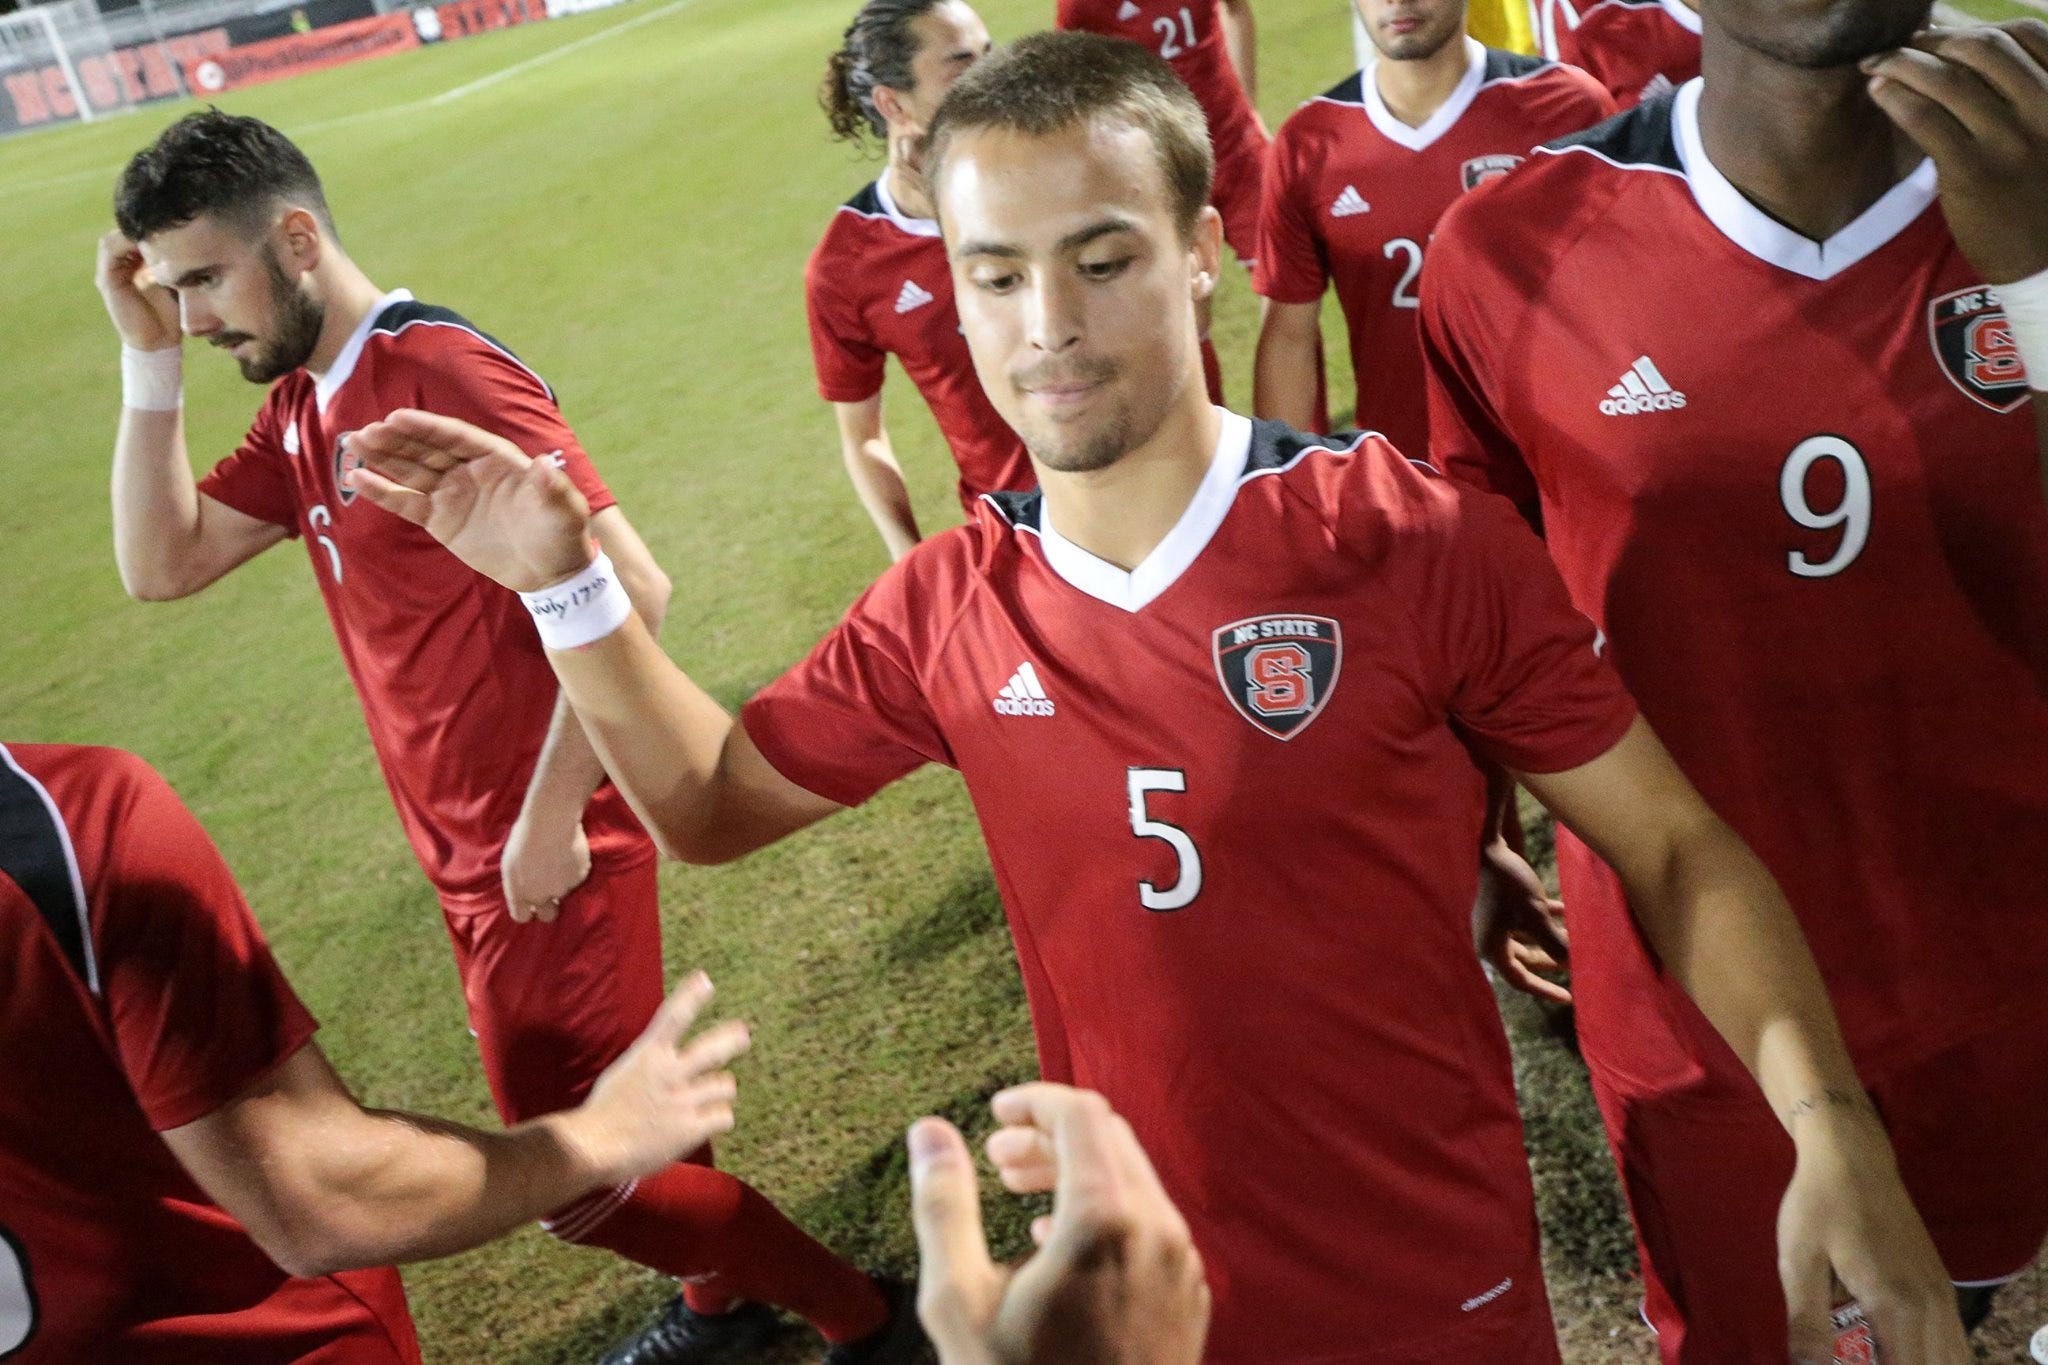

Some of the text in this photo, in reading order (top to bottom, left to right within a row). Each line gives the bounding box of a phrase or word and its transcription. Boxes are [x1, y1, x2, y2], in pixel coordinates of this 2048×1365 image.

[1152, 7, 1197, 59] 21
[1383, 236, 1434, 309] 2
[1598, 390, 1687, 416] adidas
[1779, 433, 1872, 579] 9
[1233, 619, 1320, 645] NC STATE
[992, 698, 1056, 717] adidas
[1126, 766, 1203, 912] 5
